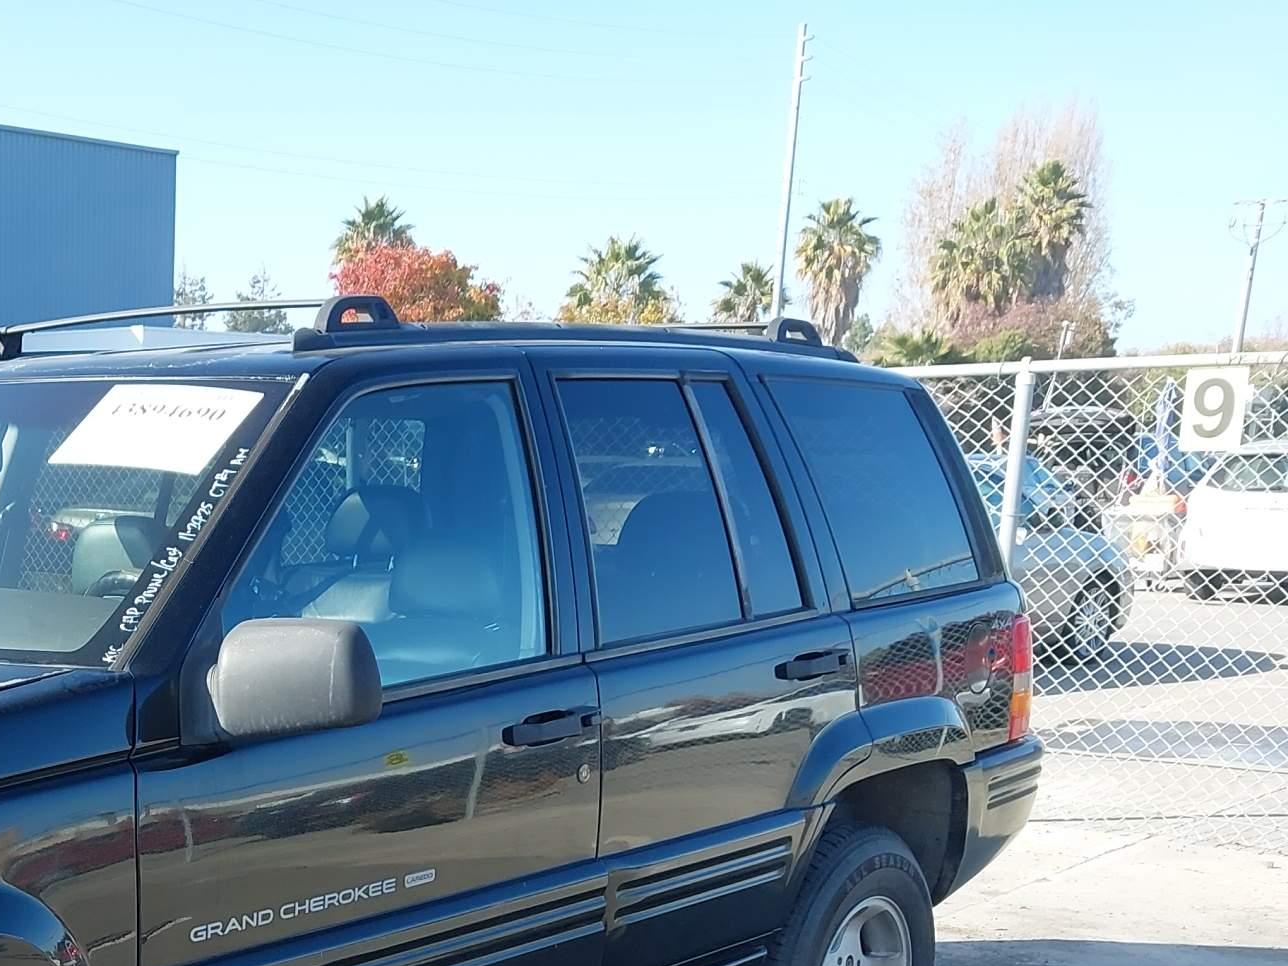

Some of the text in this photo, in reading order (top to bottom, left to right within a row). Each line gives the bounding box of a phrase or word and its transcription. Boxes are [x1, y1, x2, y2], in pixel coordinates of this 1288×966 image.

[1192, 378, 1235, 438] 9
[190, 908, 274, 942] GRAND
[279, 878, 397, 919] CHEROKEE
